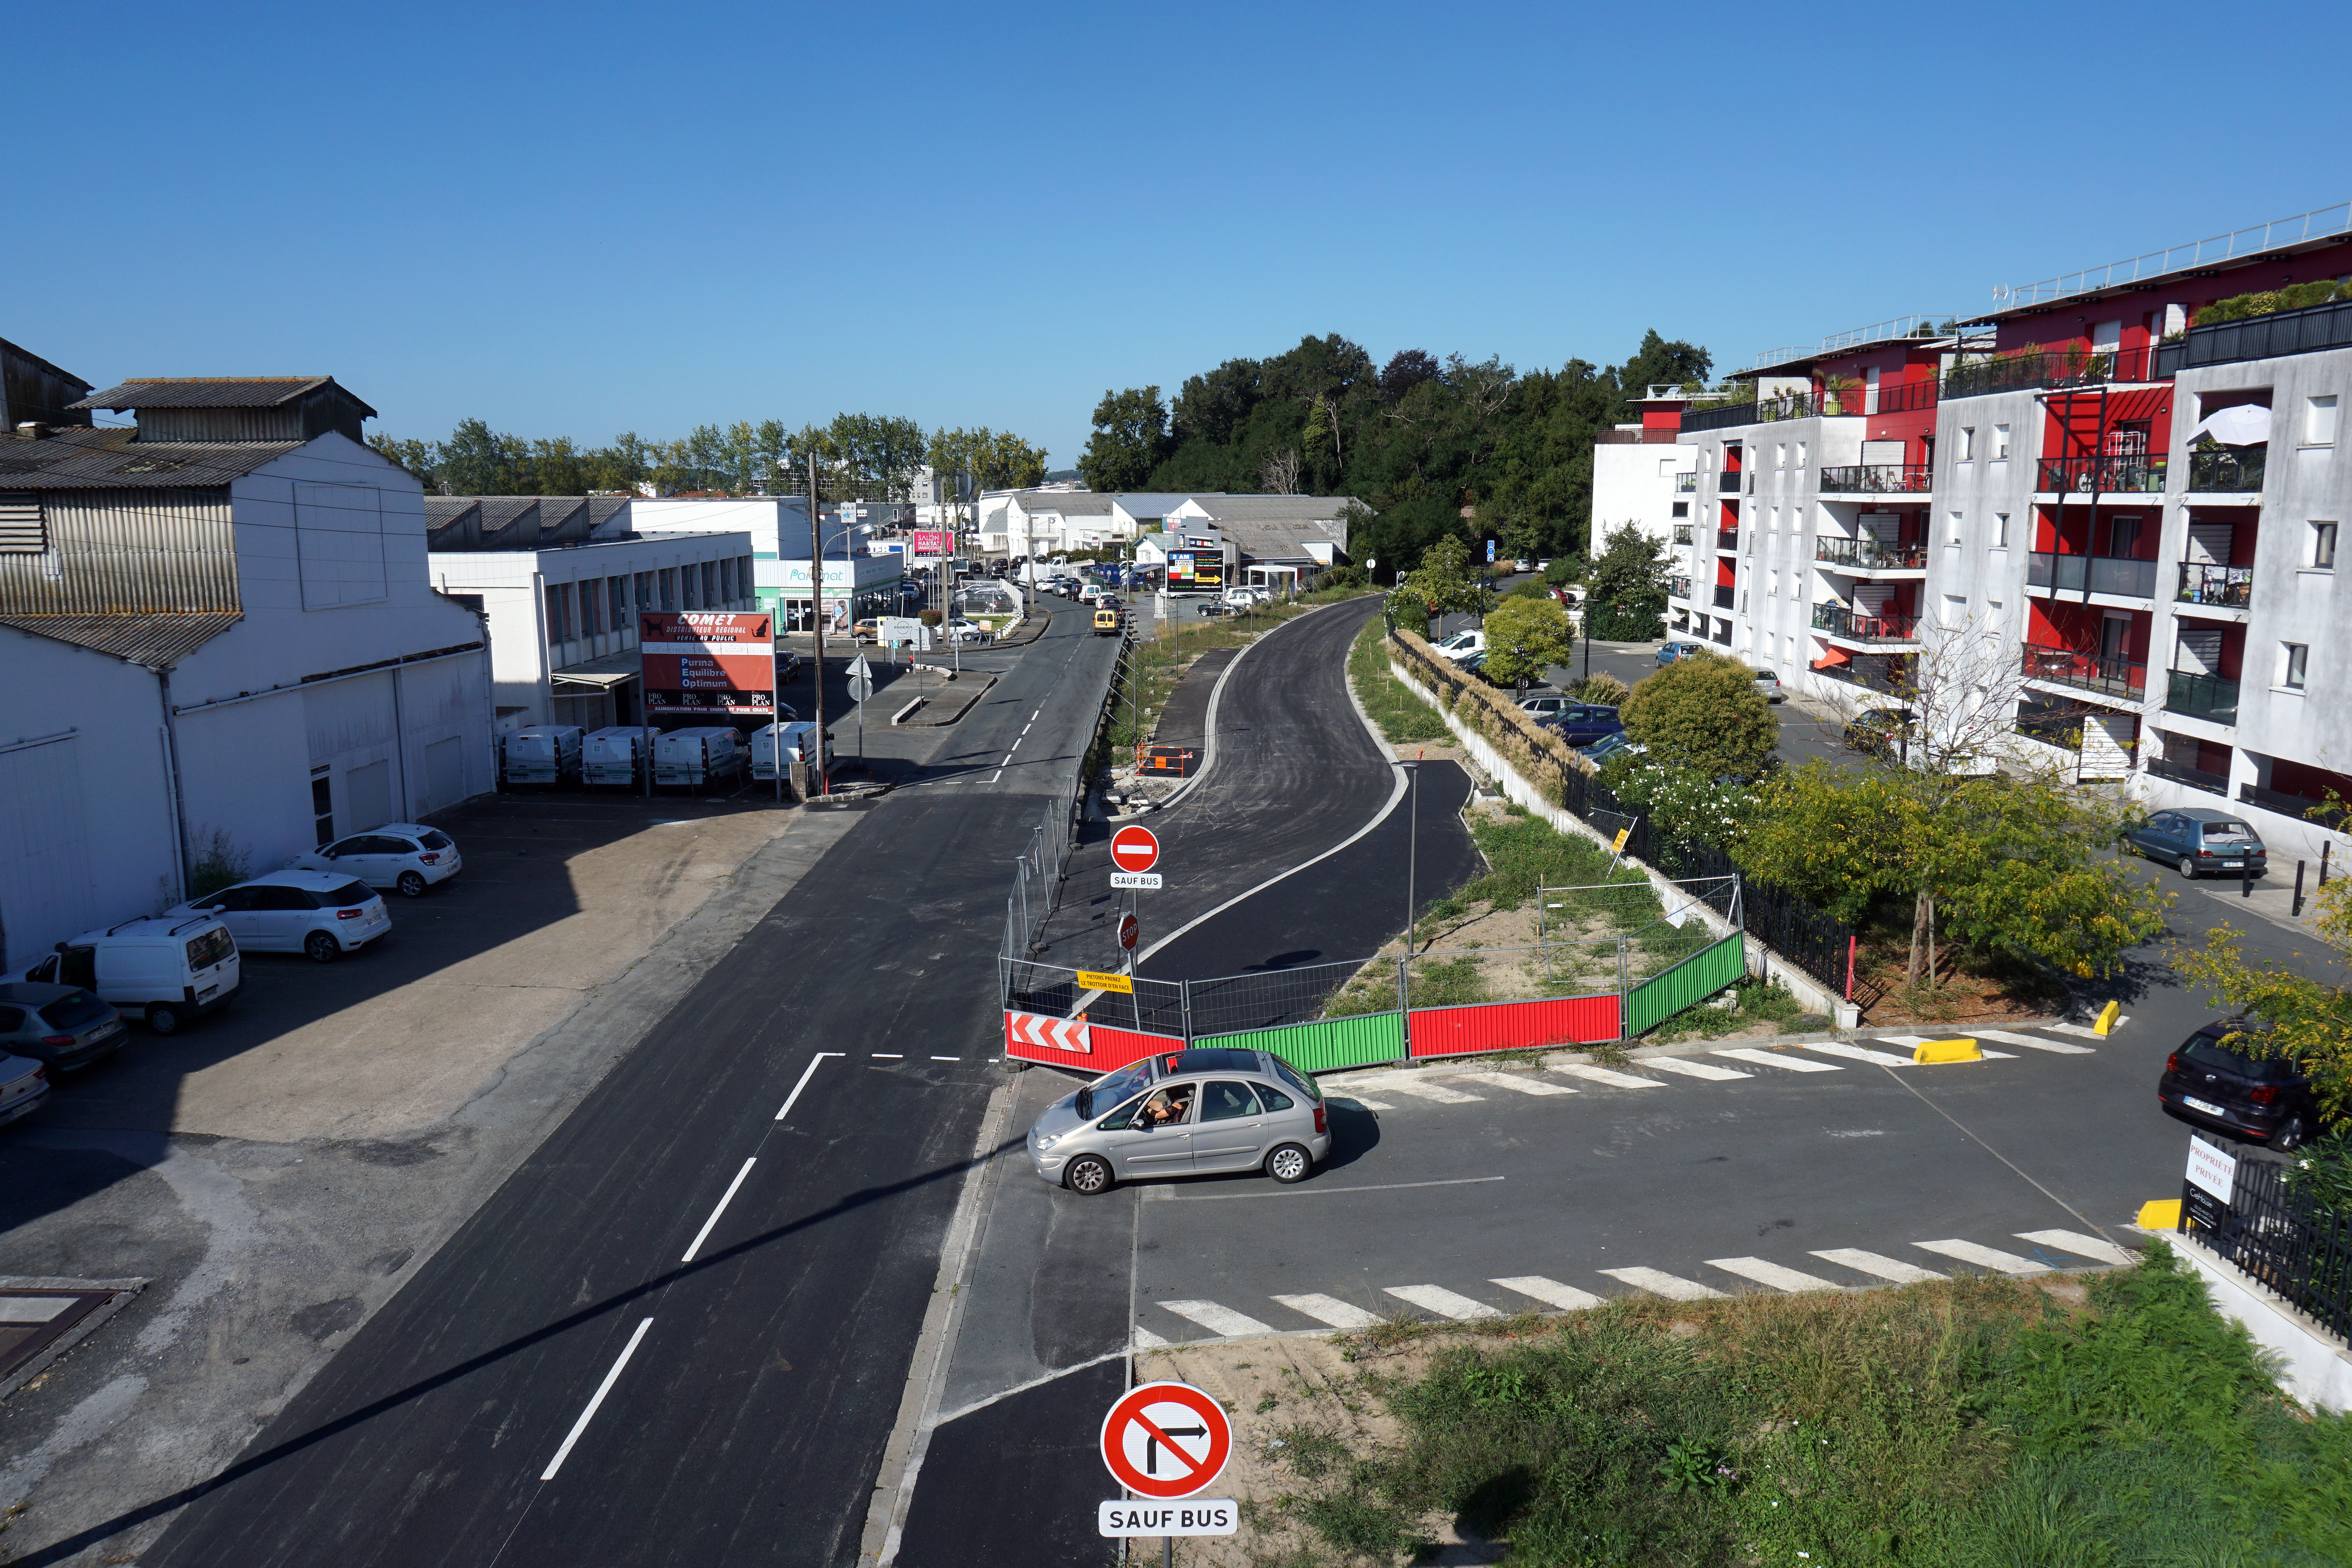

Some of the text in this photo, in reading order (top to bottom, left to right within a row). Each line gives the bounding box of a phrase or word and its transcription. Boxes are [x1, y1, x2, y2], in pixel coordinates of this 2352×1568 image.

[677, 614, 736, 626] COMET
[681, 658, 713, 666] Purina
[682, 668, 726, 677] Equilibre
[682, 679, 727, 688] Optimum
[1122, 923, 1137, 942] STOP
[2190, 1144, 2233, 1176] PROPRIÉTÉ
[2195, 1164, 2223, 1188] PRIVÉE
[1109, 1509, 1228, 1528] SAUF BUS
